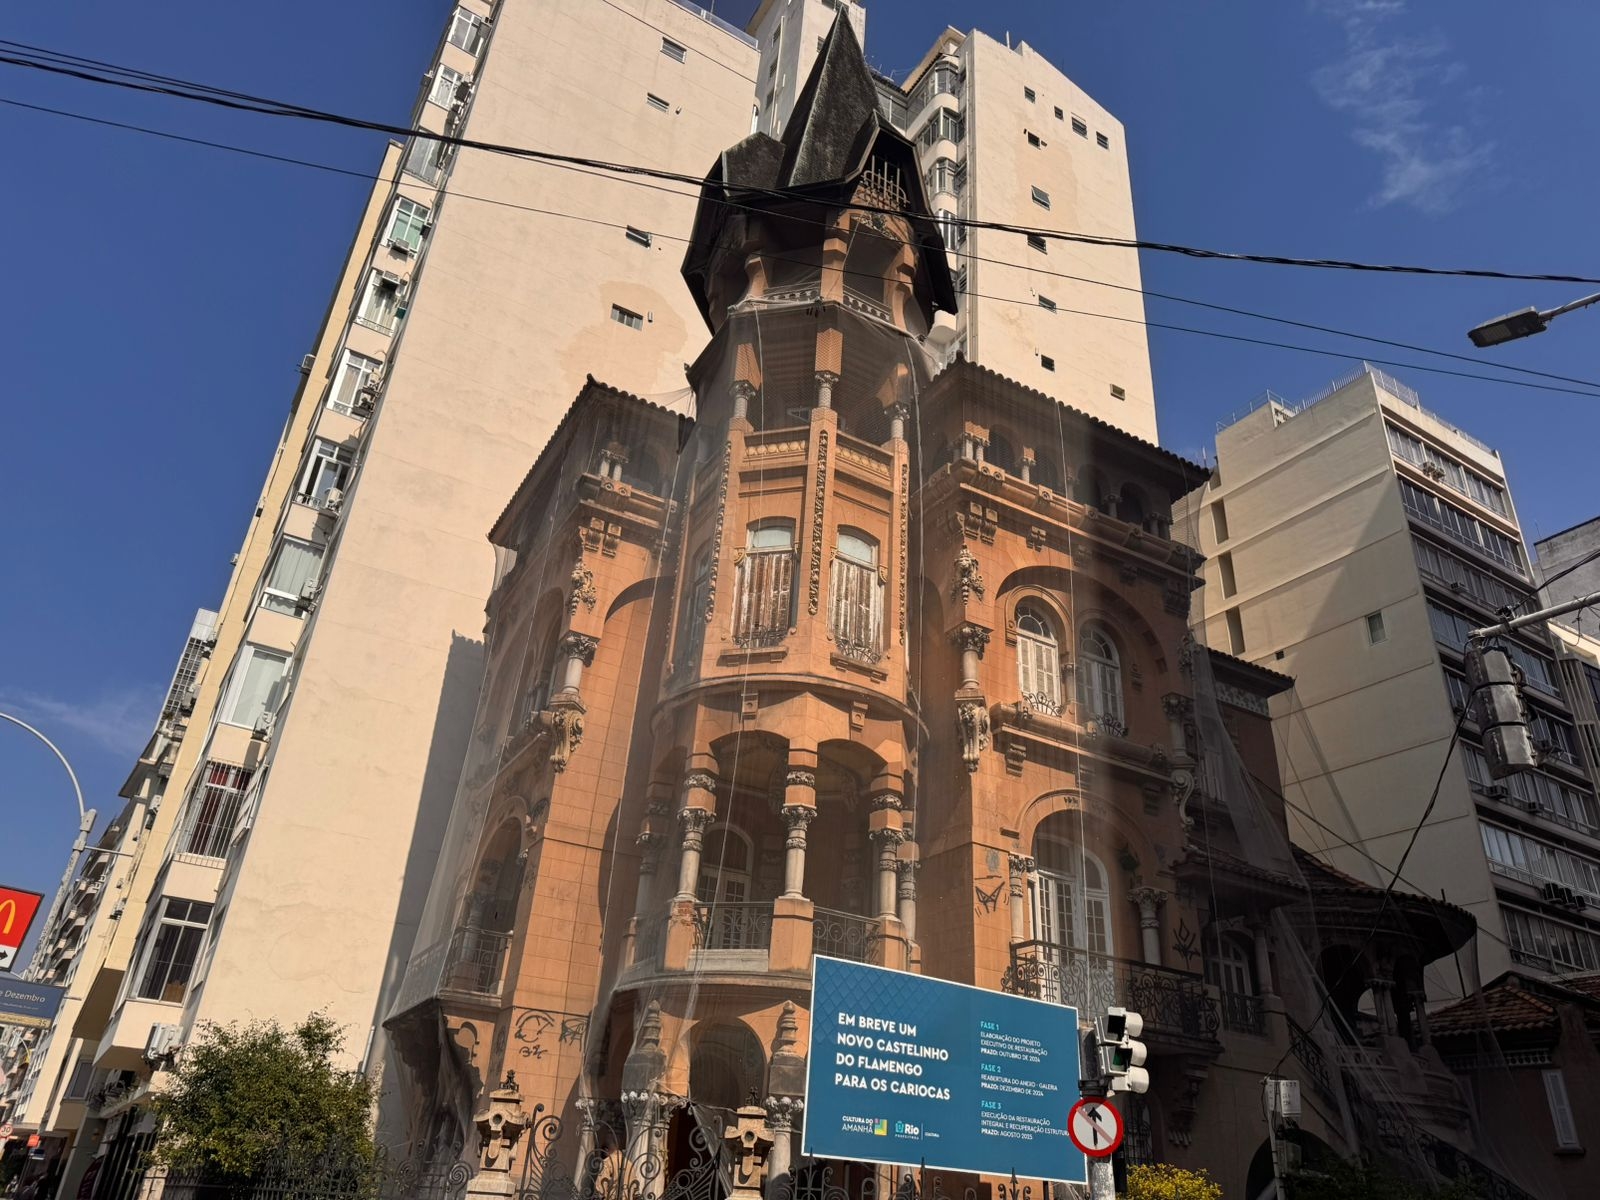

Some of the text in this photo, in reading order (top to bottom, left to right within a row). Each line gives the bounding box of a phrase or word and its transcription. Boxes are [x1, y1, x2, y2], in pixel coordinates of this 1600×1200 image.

[4, 990, 46, 1003] Dezembro
[838, 1012, 917, 1037] EM BREVE UM
[980, 1021, 995, 1030] FASE
[980, 1031, 1041, 1047] ELABORAÇÃO DO PROJETO
[837, 1032, 949, 1061] NOVO CASTELINHO
[980, 1039, 1007, 1049] EXECUTIVO
[1015, 1044, 1048, 1056] RESTAURAÇÃO
[980, 1047, 998, 1056] PRAZO:
[998, 1050, 1021, 1060] OUTUBRO
[836, 1052, 923, 1076] DO FLAMENGO
[980, 1063, 996, 1073] FASE
[835, 1072, 951, 1100] PARA OS CARIOCAS
[981, 1073, 1011, 1084] REABERTURA
[1011, 1077, 1019, 1085] DO
[1019, 1079, 1036, 1088] ANEXO
[1038, 1082, 1058, 1091] GALERIA
[981, 1081, 999, 1090] PRAZO:
[999, 1084, 1025, 1094] DEZEMBRO
[980, 1100, 1002, 1110] FASE 3
[842, 1115, 865, 1124] CULTURA
[981, 1110, 1008, 1120] EXECUÇÃO
[1015, 1115, 1051, 1126] RESTAURAÇÃO
[841, 1122, 874, 1134] AMANHÃ
[904, 1123, 920, 1135] Rio
[981, 1119, 1005, 1128] INTEGRAL
[1009, 1123, 1044, 1134] RECUPERAÇÃO
[981, 1127, 999, 1136] PRAZO:
[999, 1130, 1021, 1139] AGOSTO
